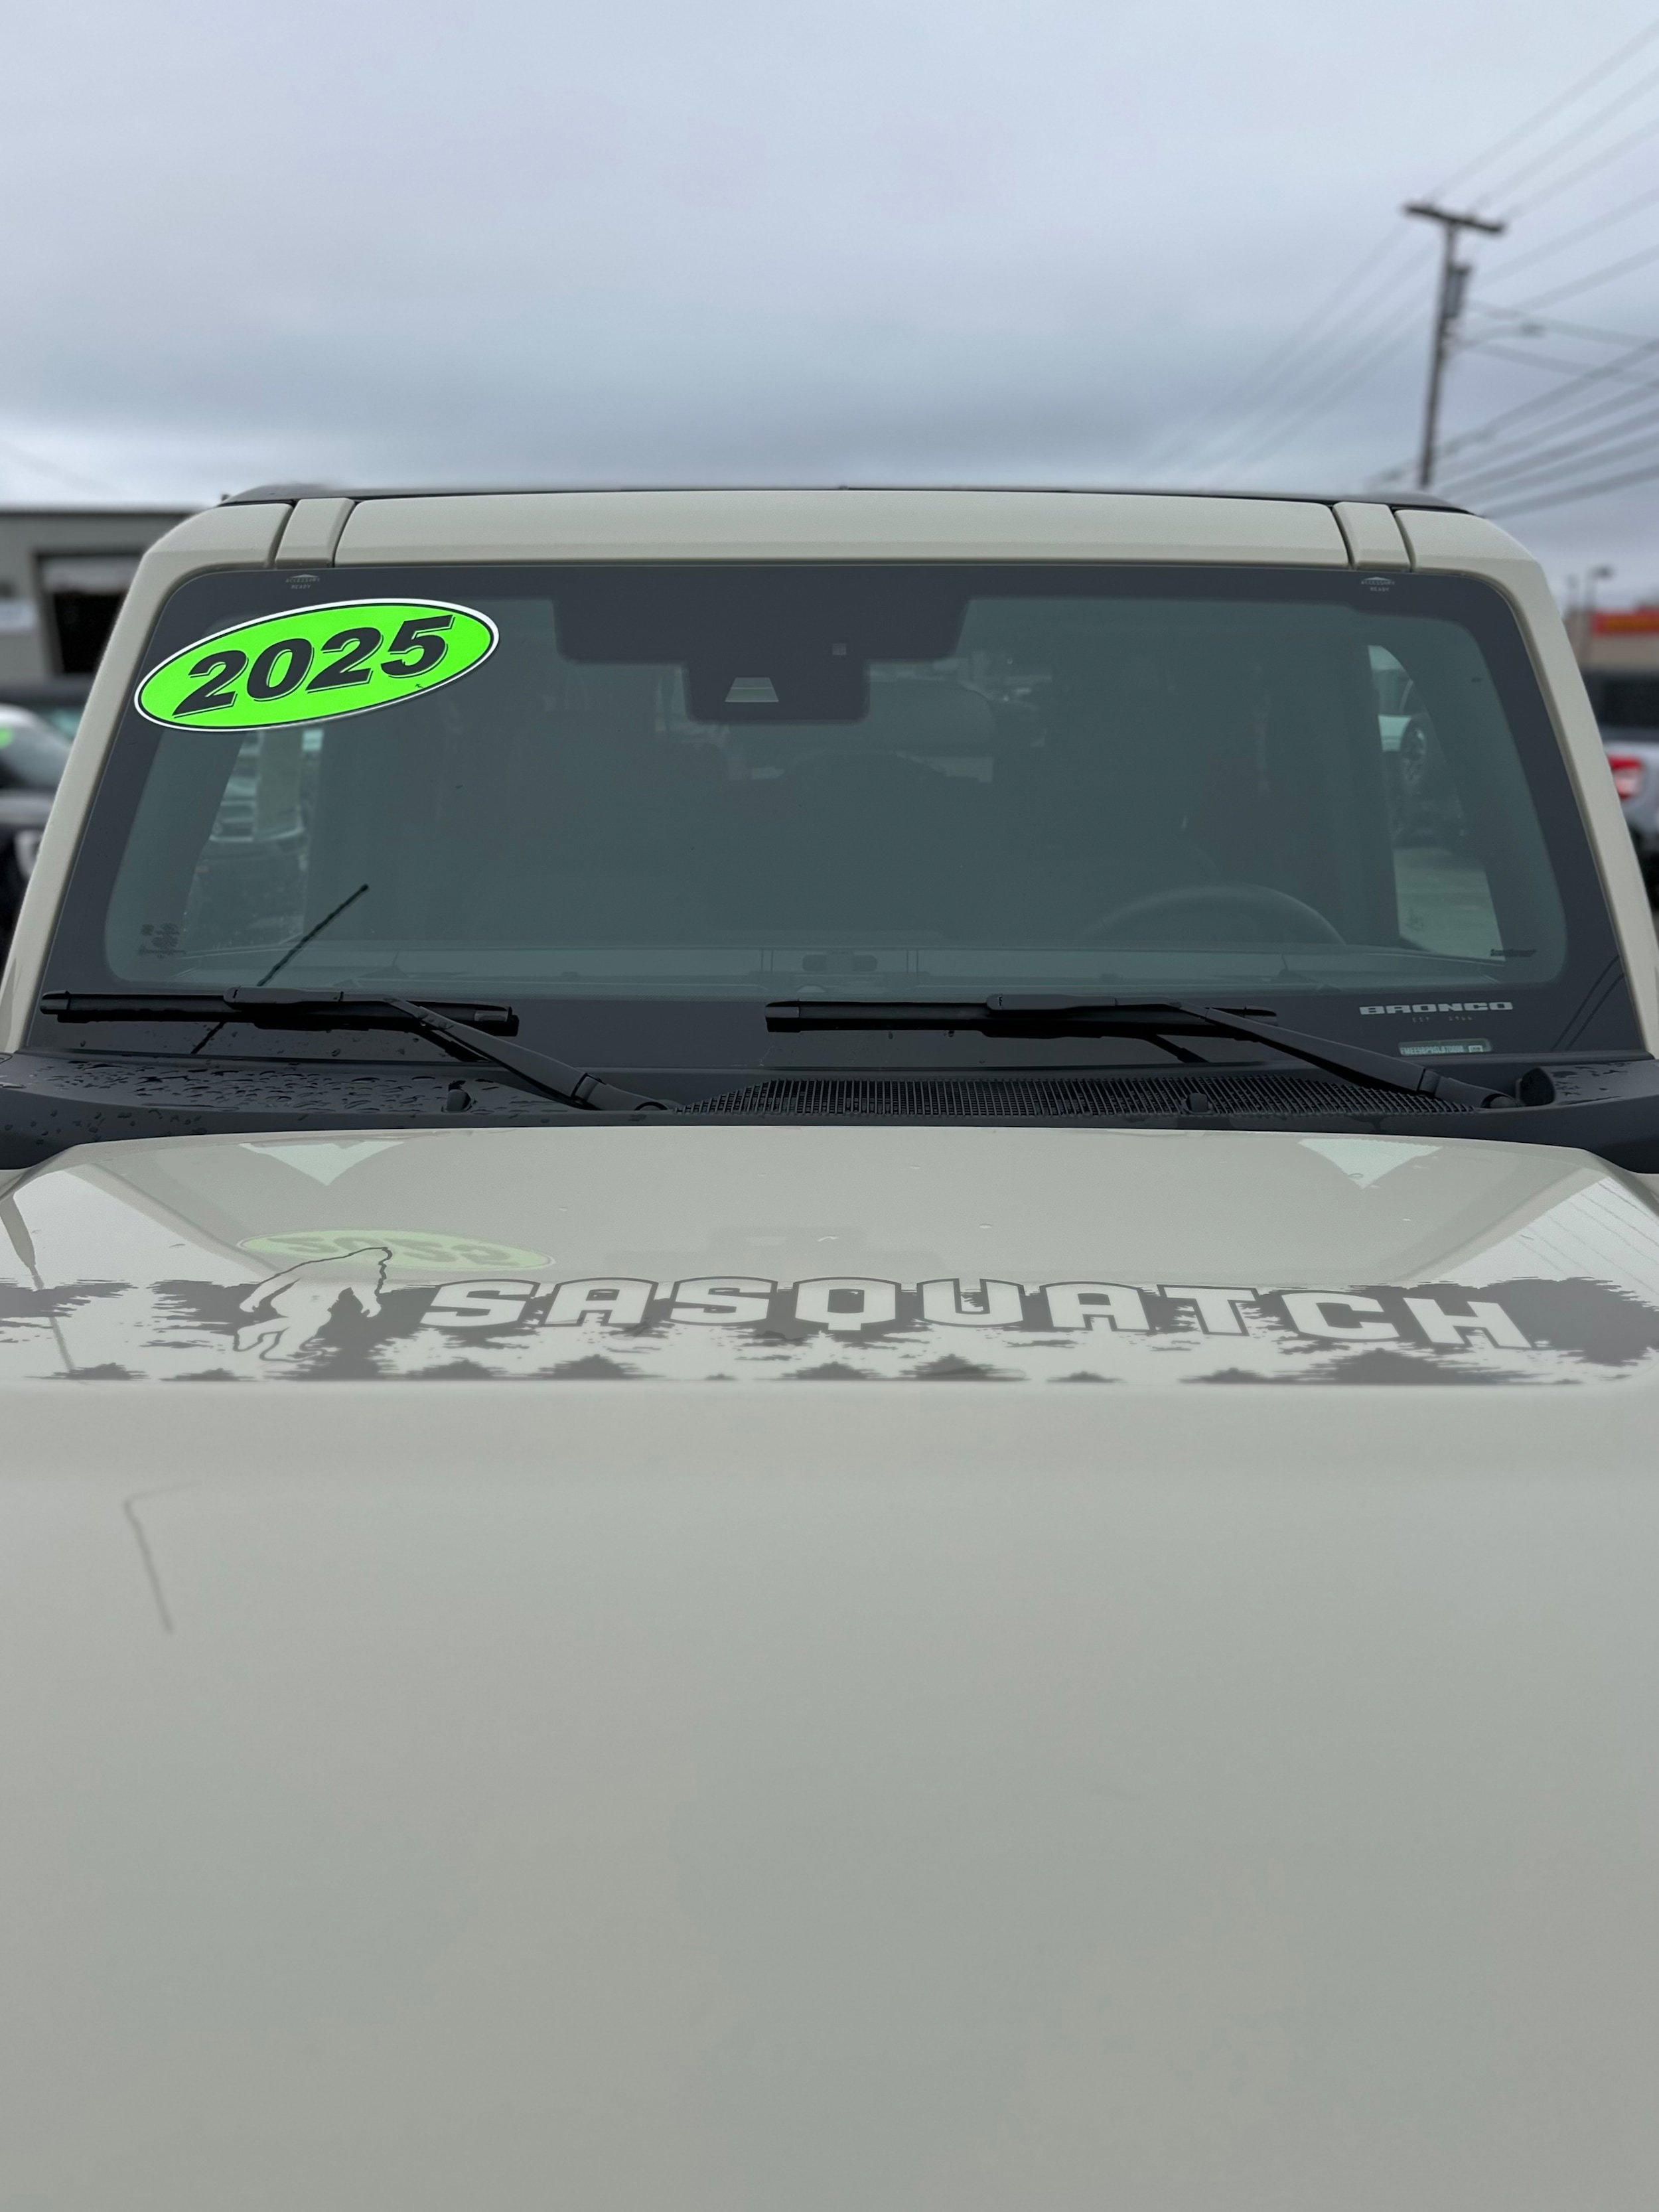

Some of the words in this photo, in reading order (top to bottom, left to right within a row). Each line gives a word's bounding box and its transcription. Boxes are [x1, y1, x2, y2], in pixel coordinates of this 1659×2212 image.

[172, 614, 456, 719] 2025
[1359, 1001, 1513, 1015] BRONCO
[419, 1276, 1534, 1349] SASQUATCH
